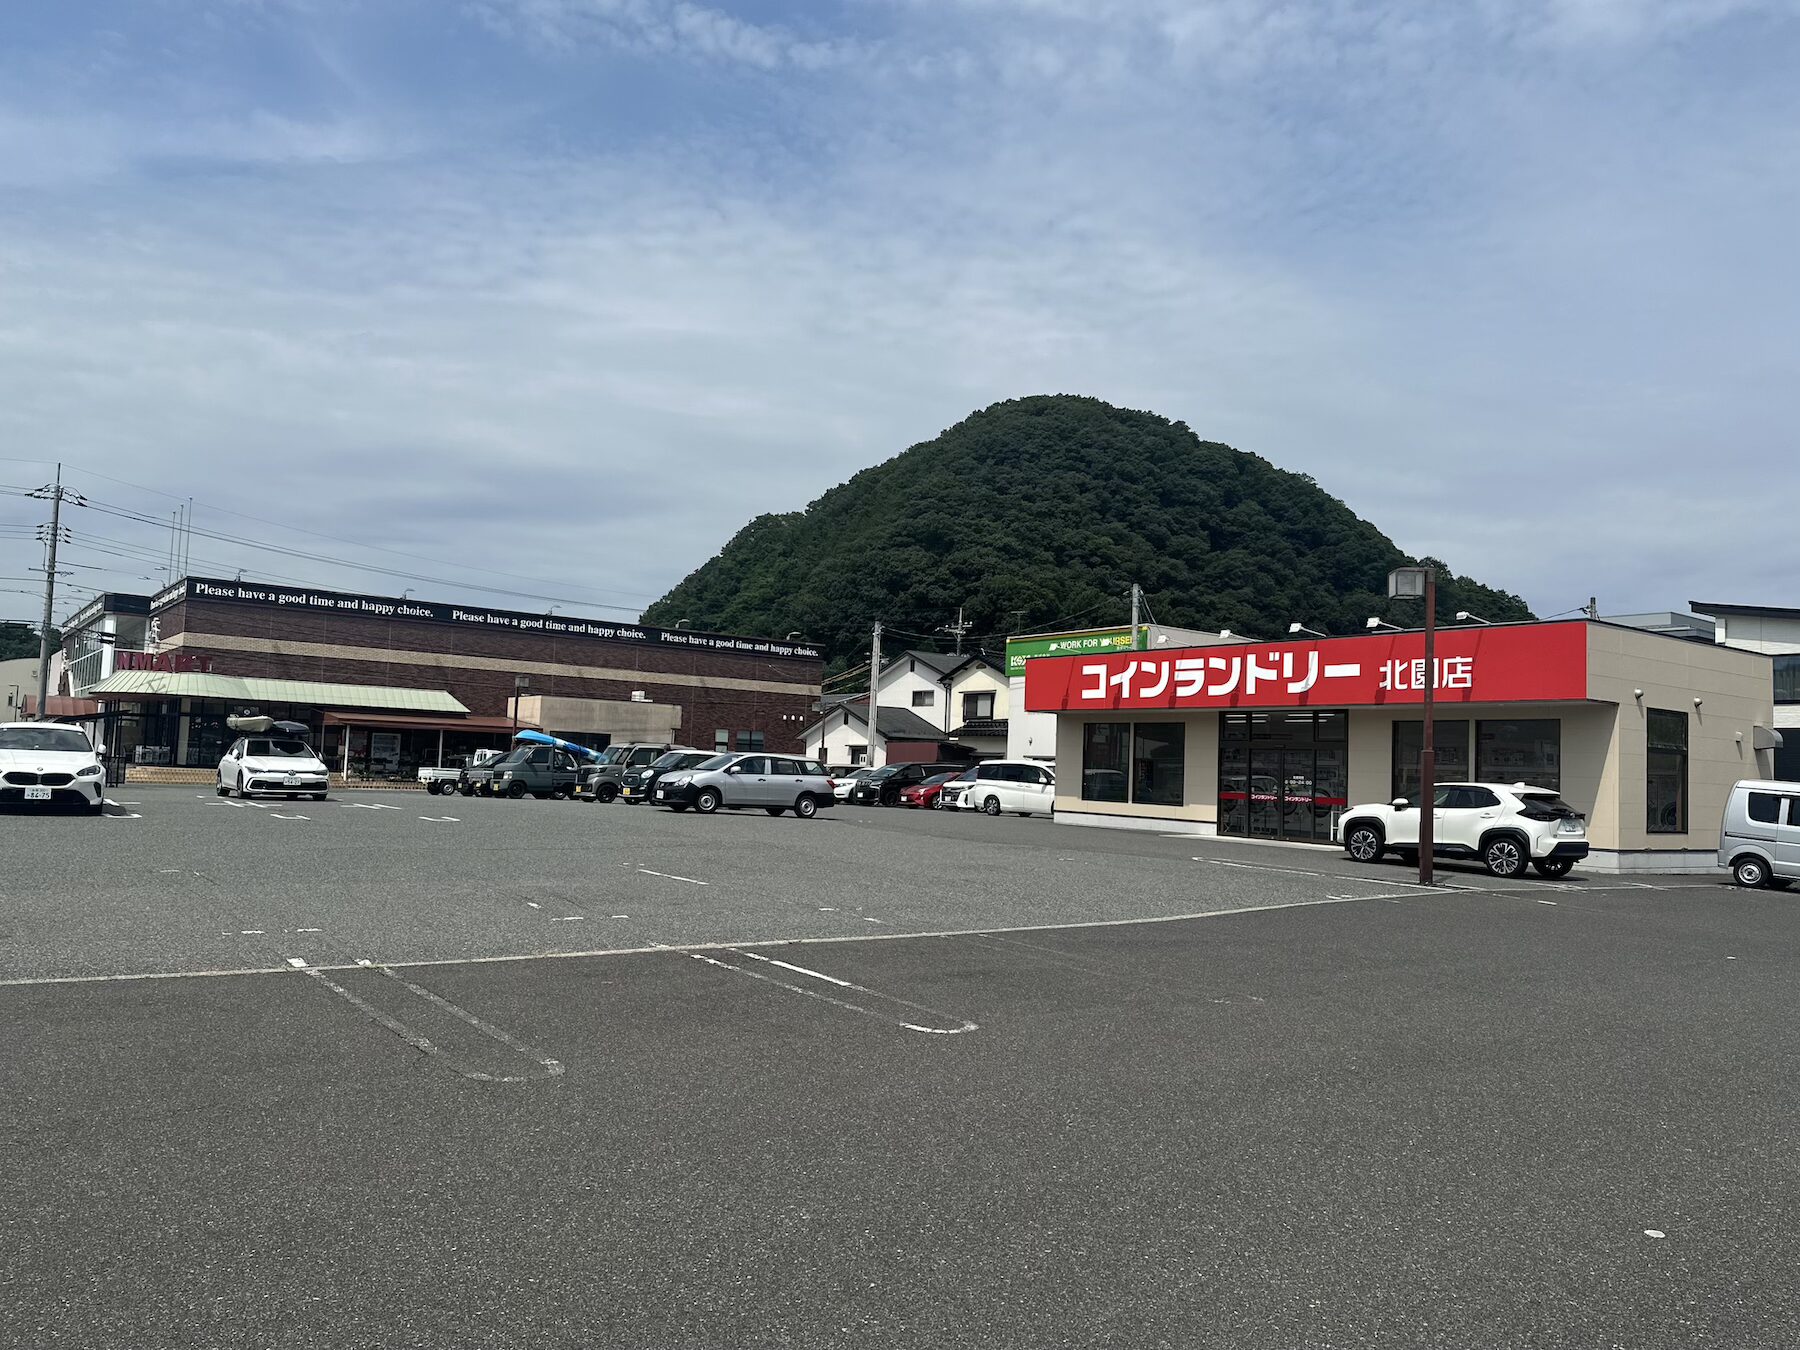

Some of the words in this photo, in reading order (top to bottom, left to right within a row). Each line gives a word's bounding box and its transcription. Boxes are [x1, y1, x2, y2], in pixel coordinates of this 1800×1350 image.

[195, 583, 234, 597] Please
[238, 587, 266, 600] have
[268, 593, 276, 602] a
[278, 593, 306, 605] good
[309, 595, 335, 607] time
[337, 598, 358, 610] and
[362, 601, 394, 615] happy
[397, 604, 434, 618] choice.
[452, 610, 485, 623] Please
[487, 614, 510, 625] have
[520, 619, 543, 629] good
[545, 621, 566, 631] time
[568, 623, 586, 633] and
[588, 626, 615, 637] happy
[617, 628, 647, 639] choice.
[661, 632, 687, 643] Please
[689, 634, 708, 645] have
[716, 639, 735, 648] good
[736, 641, 754, 650] time
[755, 643, 769, 652] and
[770, 643, 793, 655] happy
[794, 647, 818, 657] choice.
[1060, 639, 1082, 649] WORK
[1083, 638, 1098, 648] FOR
[1081, 651, 1361, 699] コインランドリー
[1378, 656, 1473, 691] 北園店
